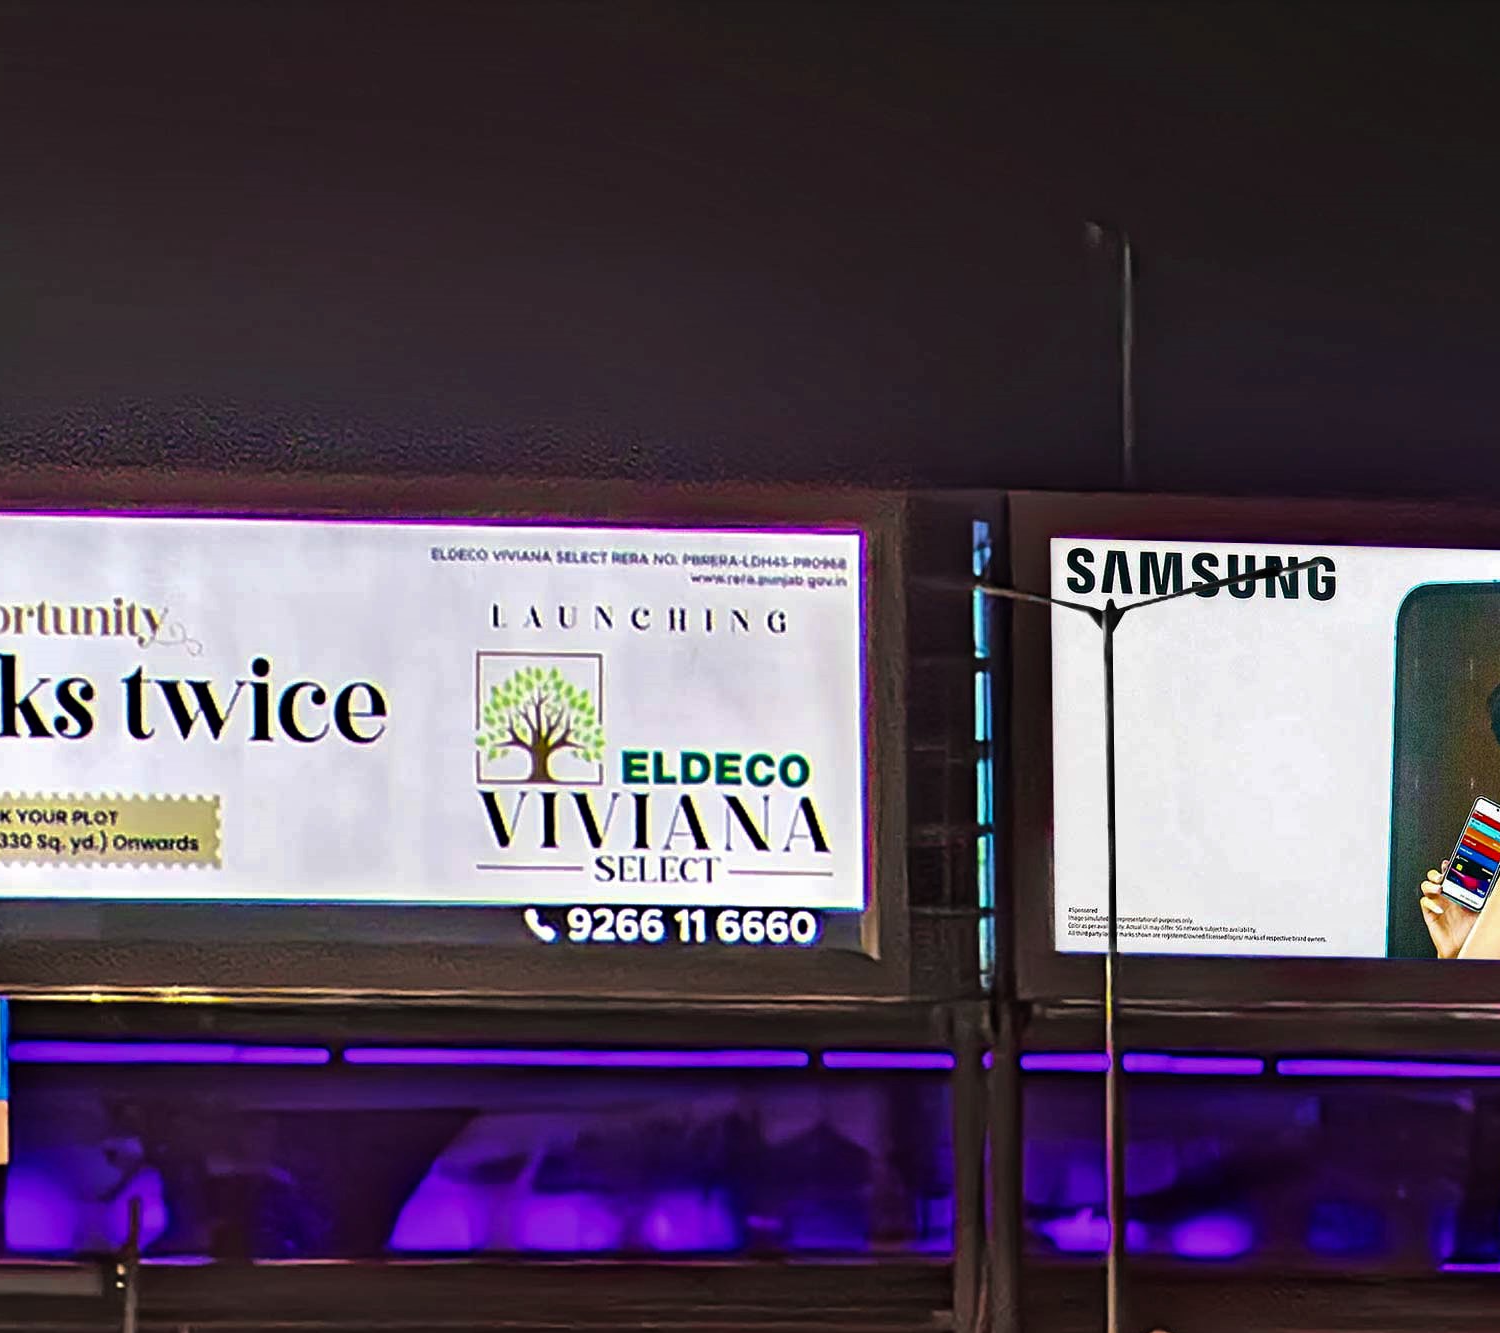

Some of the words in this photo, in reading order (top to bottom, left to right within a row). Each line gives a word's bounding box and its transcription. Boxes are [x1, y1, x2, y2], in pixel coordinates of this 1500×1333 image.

[430, 547, 488, 562] ELDECO
[492, 548, 552, 563] VIVIANA
[555, 550, 608, 565] SELECT
[1066, 547, 1337, 601] SAMSUNG
[491, 602, 787, 634] LAUNCHING
[122, 656, 388, 744] twice
[620, 749, 811, 788] ELDECO
[15, 809, 67, 827] YOUR
[70, 810, 119, 827] PLOT
[478, 790, 833, 854] VIVIANA
[36, 832, 67, 853] Sq.
[112, 833, 200, 852] Onwards
[593, 855, 723, 884] SELECT
[566, 907, 666, 943] 9266
[673, 908, 706, 943] 11
[715, 909, 818, 944] 6660
